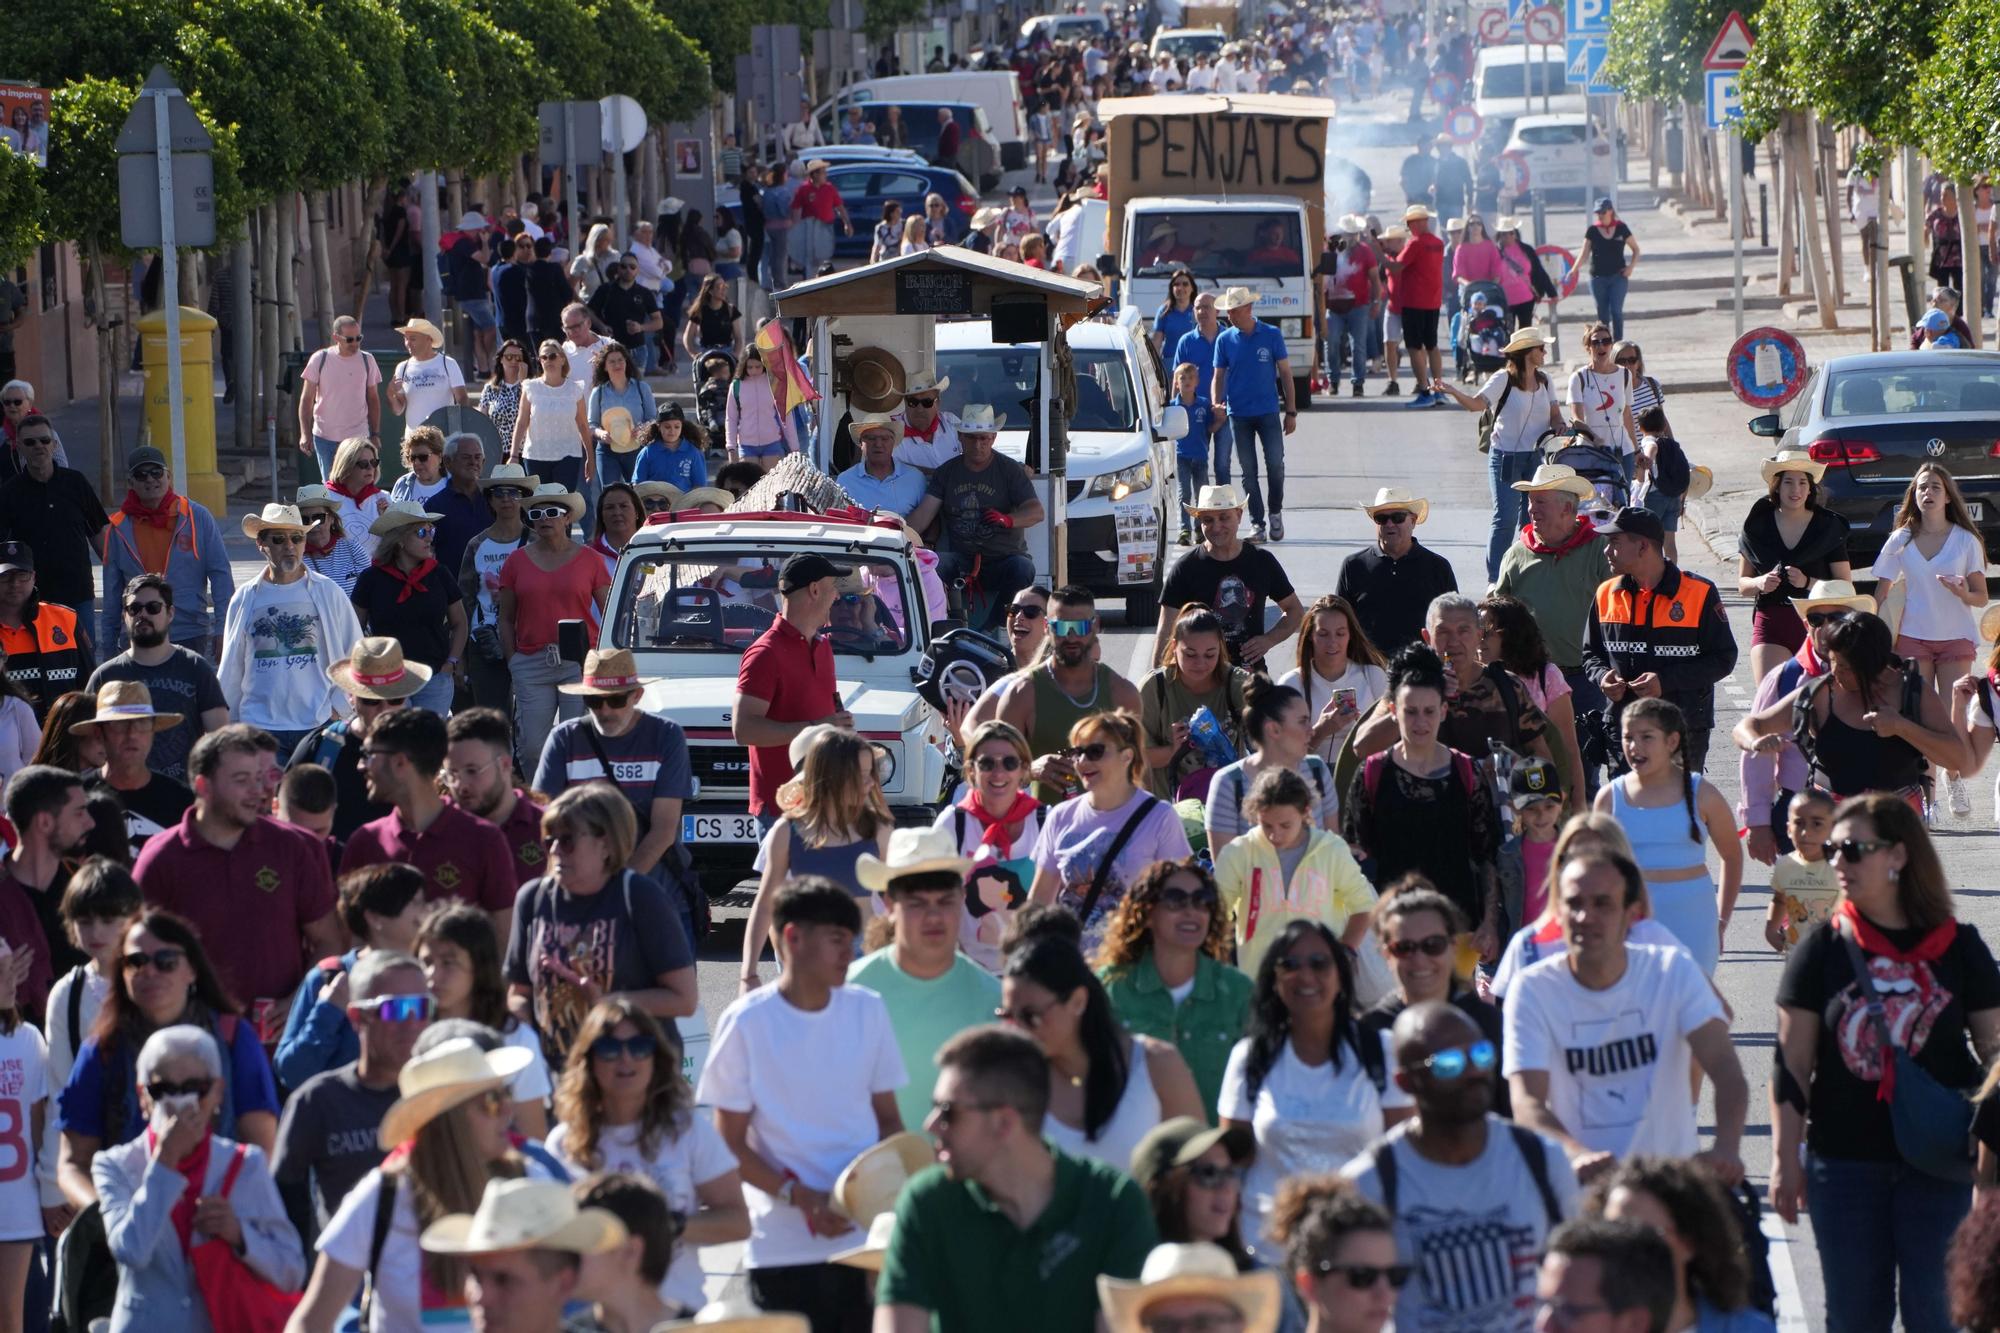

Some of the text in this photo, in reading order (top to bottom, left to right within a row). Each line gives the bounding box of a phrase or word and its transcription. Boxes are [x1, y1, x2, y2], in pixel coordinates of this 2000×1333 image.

[1576, 0, 1602, 30] P
[8, 88, 43, 100] importa
[1713, 77, 1744, 122] P
[1132, 114, 1322, 186] PENJATS
[696, 818, 722, 838] CS
[1565, 1032, 1657, 1076] PUMA
